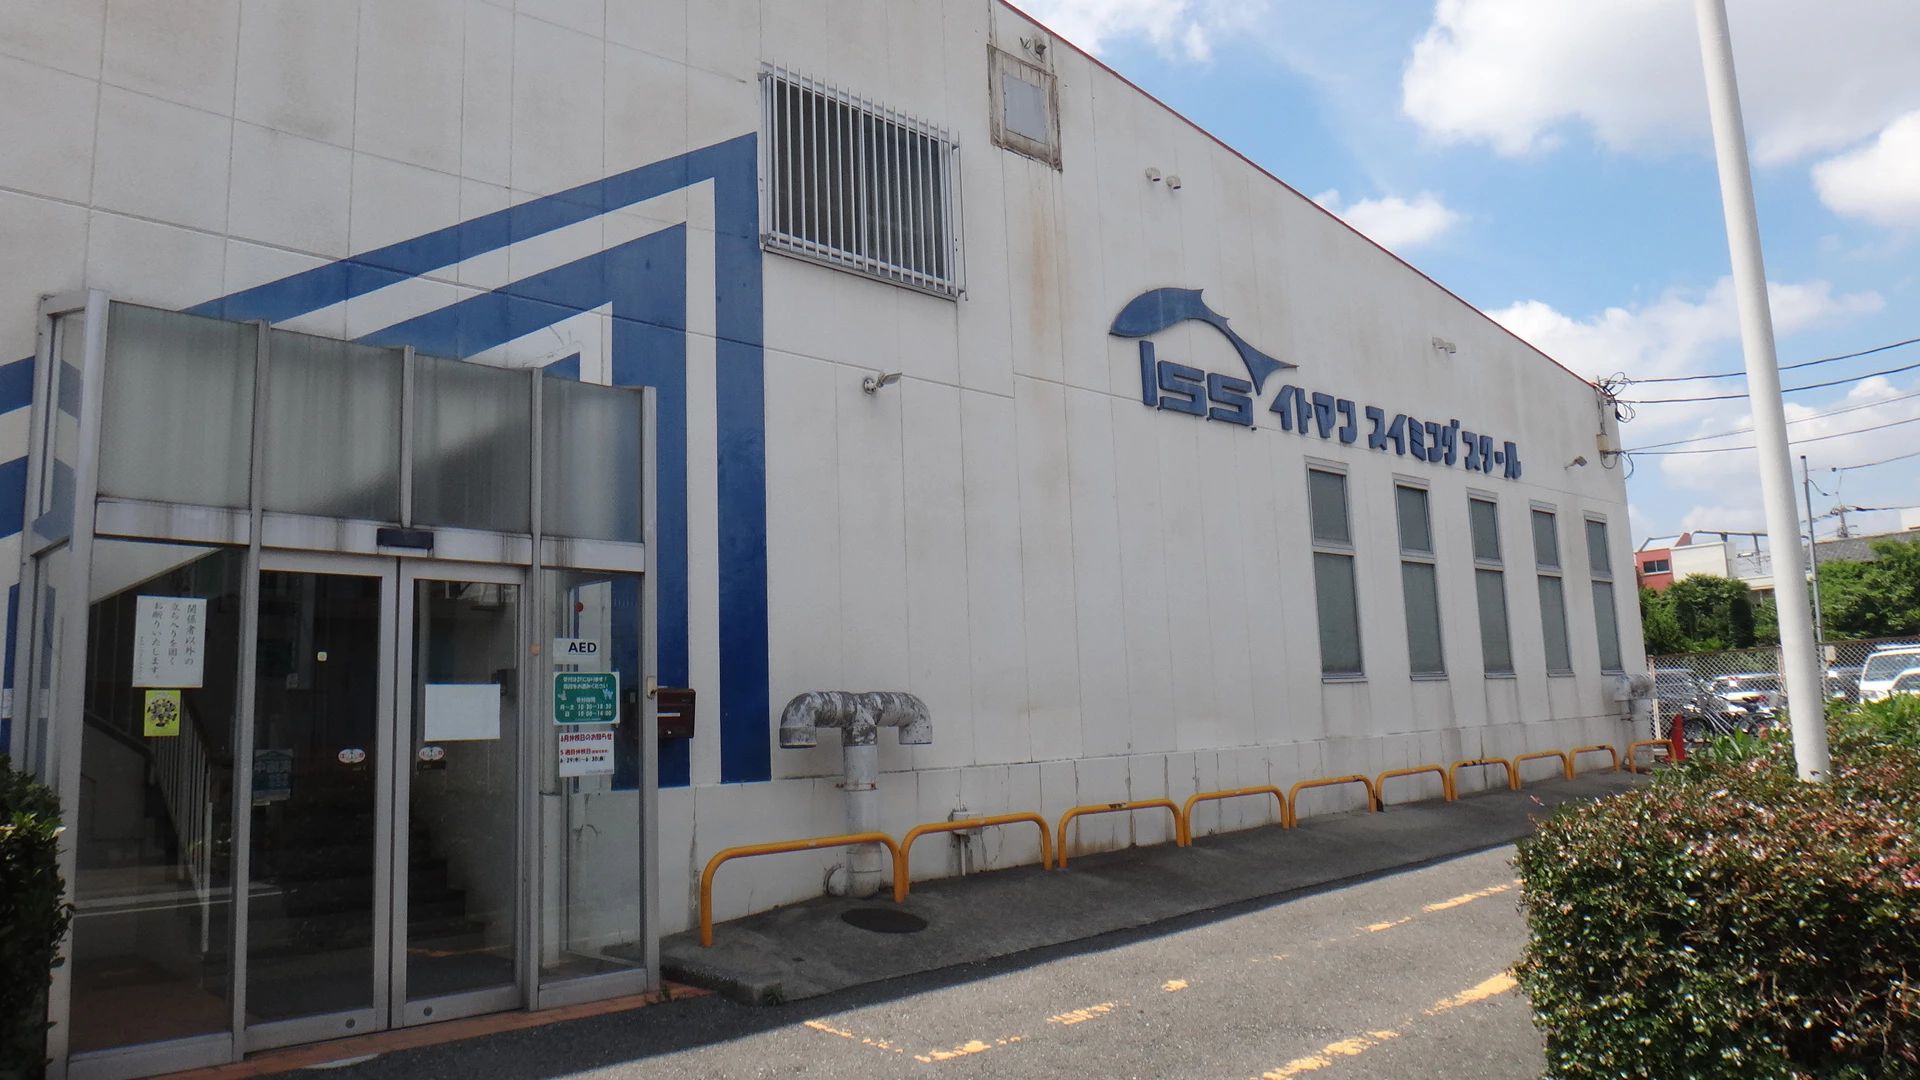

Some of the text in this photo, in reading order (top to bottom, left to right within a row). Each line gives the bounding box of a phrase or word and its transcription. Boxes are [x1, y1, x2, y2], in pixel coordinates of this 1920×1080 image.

[1269, 384, 1522, 480] イトマン スイミング スクール
[568, 641, 597, 653] AED
